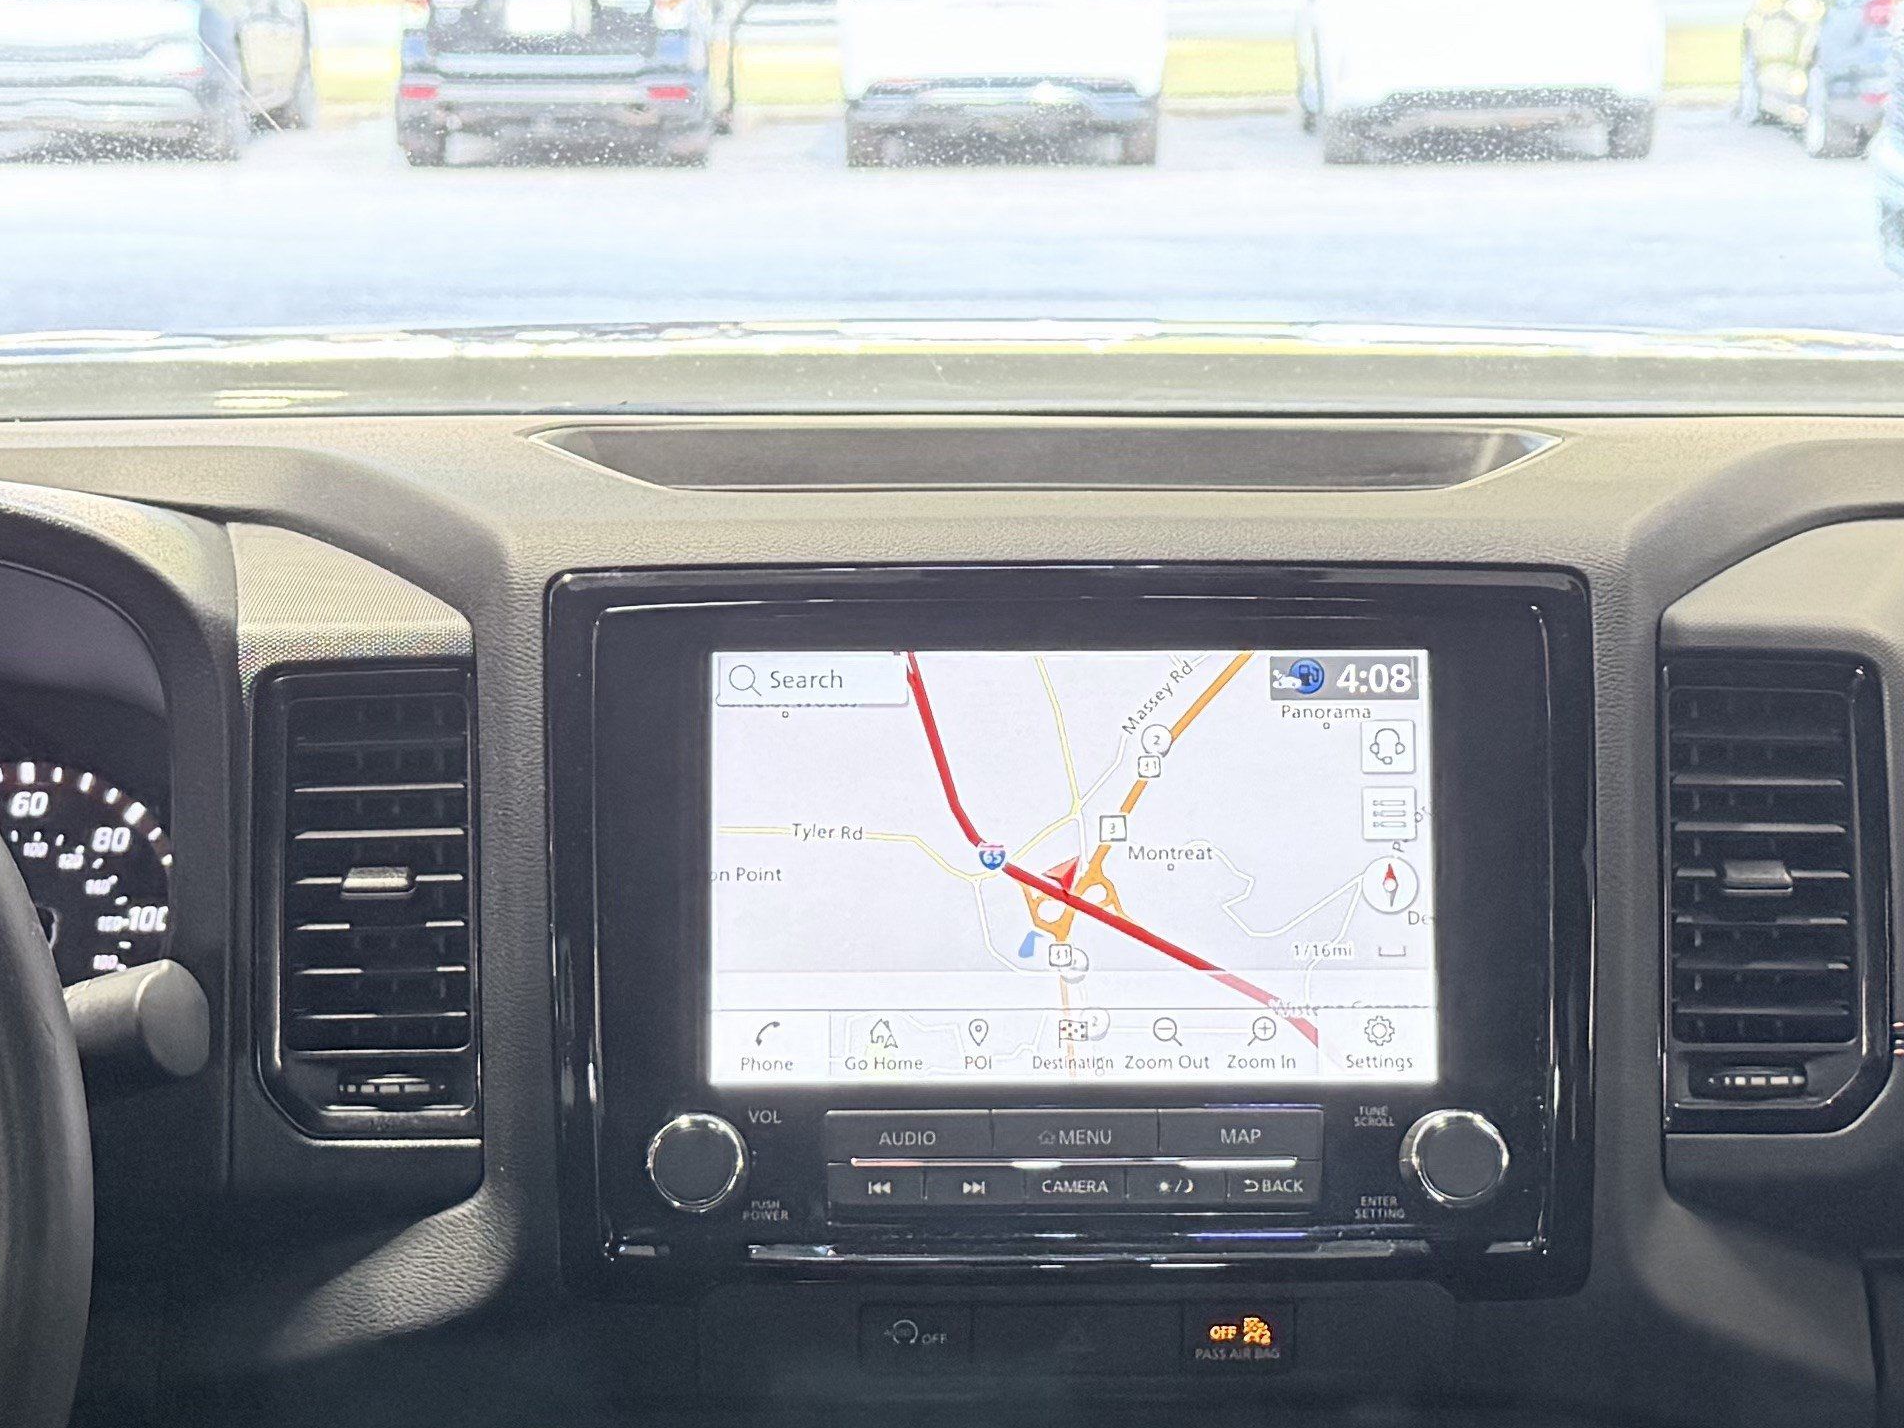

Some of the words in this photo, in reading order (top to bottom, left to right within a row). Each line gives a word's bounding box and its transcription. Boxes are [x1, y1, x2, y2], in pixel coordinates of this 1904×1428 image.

[769, 670, 844, 690] Search
[1336, 663, 1413, 693] 4:08
[1122, 682, 1174, 735] Massey
[1169, 660, 1194, 683] Rd
[1281, 704, 1372, 719] Panorama
[9, 790, 49, 817] 60
[91, 826, 131, 853] 80
[792, 823, 836, 840] Tyler
[841, 826, 864, 841] Rd
[984, 851, 1002, 866] 65
[1128, 845, 1213, 861] Montreat
[736, 868, 782, 882] Point
[740, 1057, 794, 1072] Phone
[844, 1056, 868, 1072] Go
[874, 1056, 923, 1071] Home
[964, 1056, 992, 1070] POI
[1033, 1055, 1114, 1070] Destination
[1125, 1055, 1173, 1070] Zoom
[1179, 1055, 1210, 1070] Out
[1227, 1054, 1276, 1069] Zoom
[1282, 1054, 1297, 1069] In
[1345, 1054, 1414, 1072] Settings
[748, 1110, 783, 1124] VOL
[1354, 1116, 1395, 1127] SCROLL
[878, 1130, 937, 1146] AUDIO
[1058, 1129, 1113, 1146] MENU
[1220, 1128, 1262, 1145] MAP
[1041, 1179, 1109, 1194] CAMERA
[1262, 1179, 1304, 1193] BACK
[1360, 1196, 1398, 1207] ENTER
[743, 1210, 789, 1221] POWER
[1354, 1208, 1406, 1220] SETTING
[921, 1334, 948, 1346] OFF
[1210, 1326, 1238, 1341] OFF
